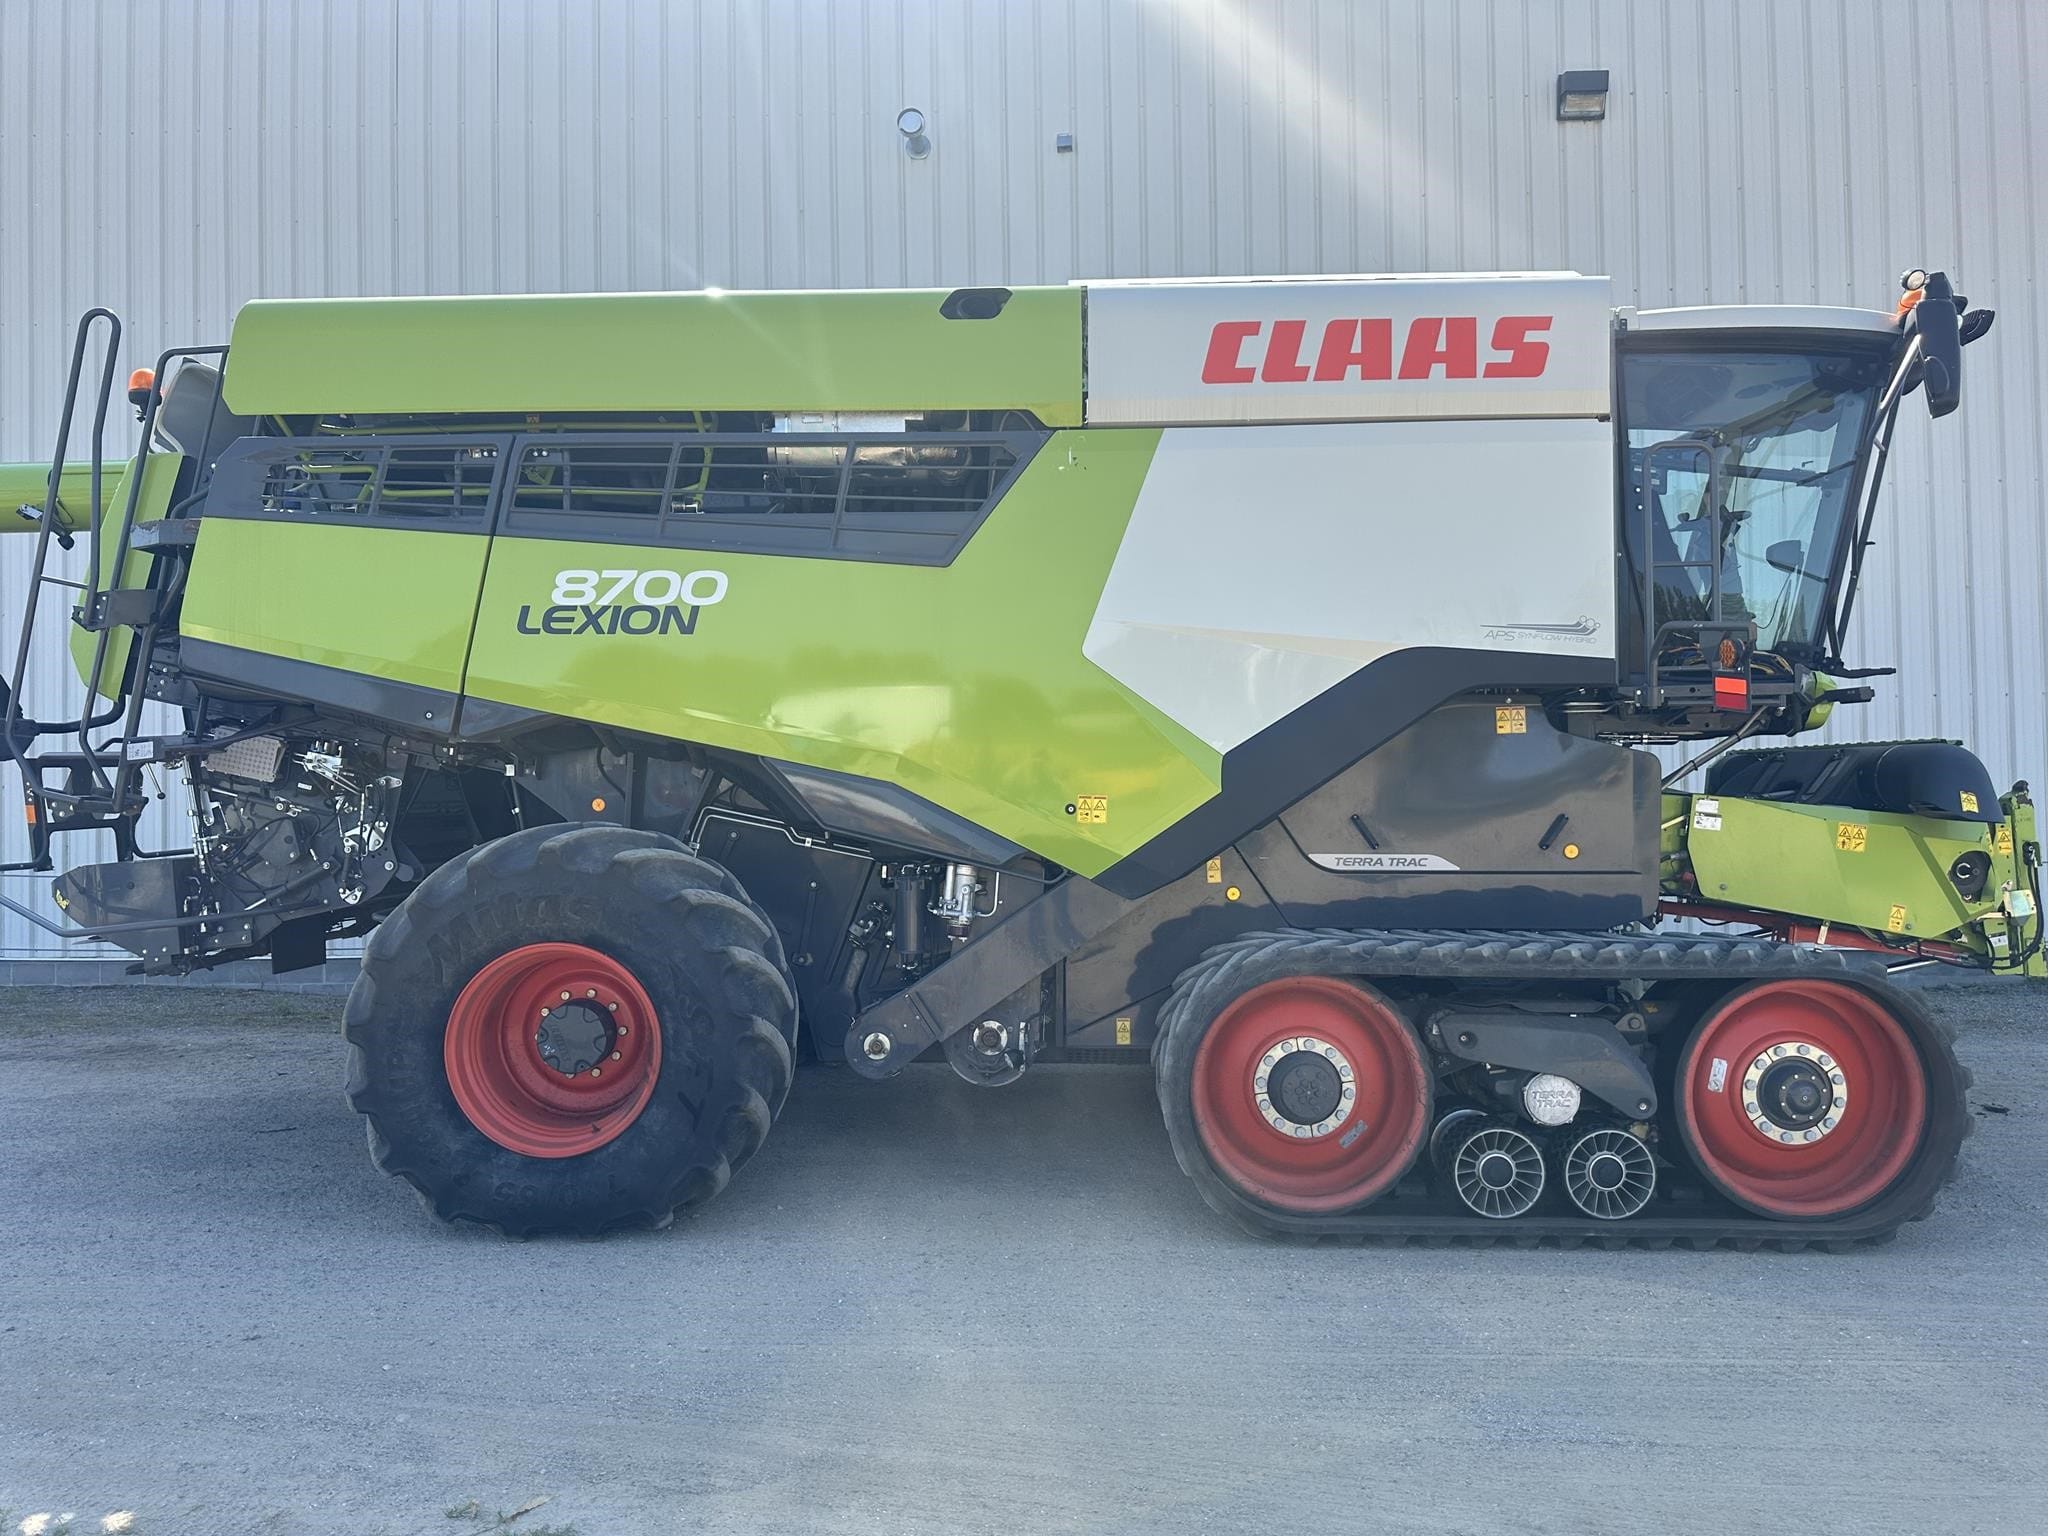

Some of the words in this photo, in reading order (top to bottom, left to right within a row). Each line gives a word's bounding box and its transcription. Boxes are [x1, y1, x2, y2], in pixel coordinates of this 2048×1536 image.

[1201, 316, 1553, 384] CLAAS
[551, 569, 729, 606] 8700
[516, 605, 700, 635] LEXION
[1483, 630, 1517, 641] APS
[1334, 857, 1384, 867] TERRA
[1388, 857, 1429, 867] TRAC
[1532, 1089, 1575, 1099] TERRA
[1536, 1098, 1572, 1108] TRAC
